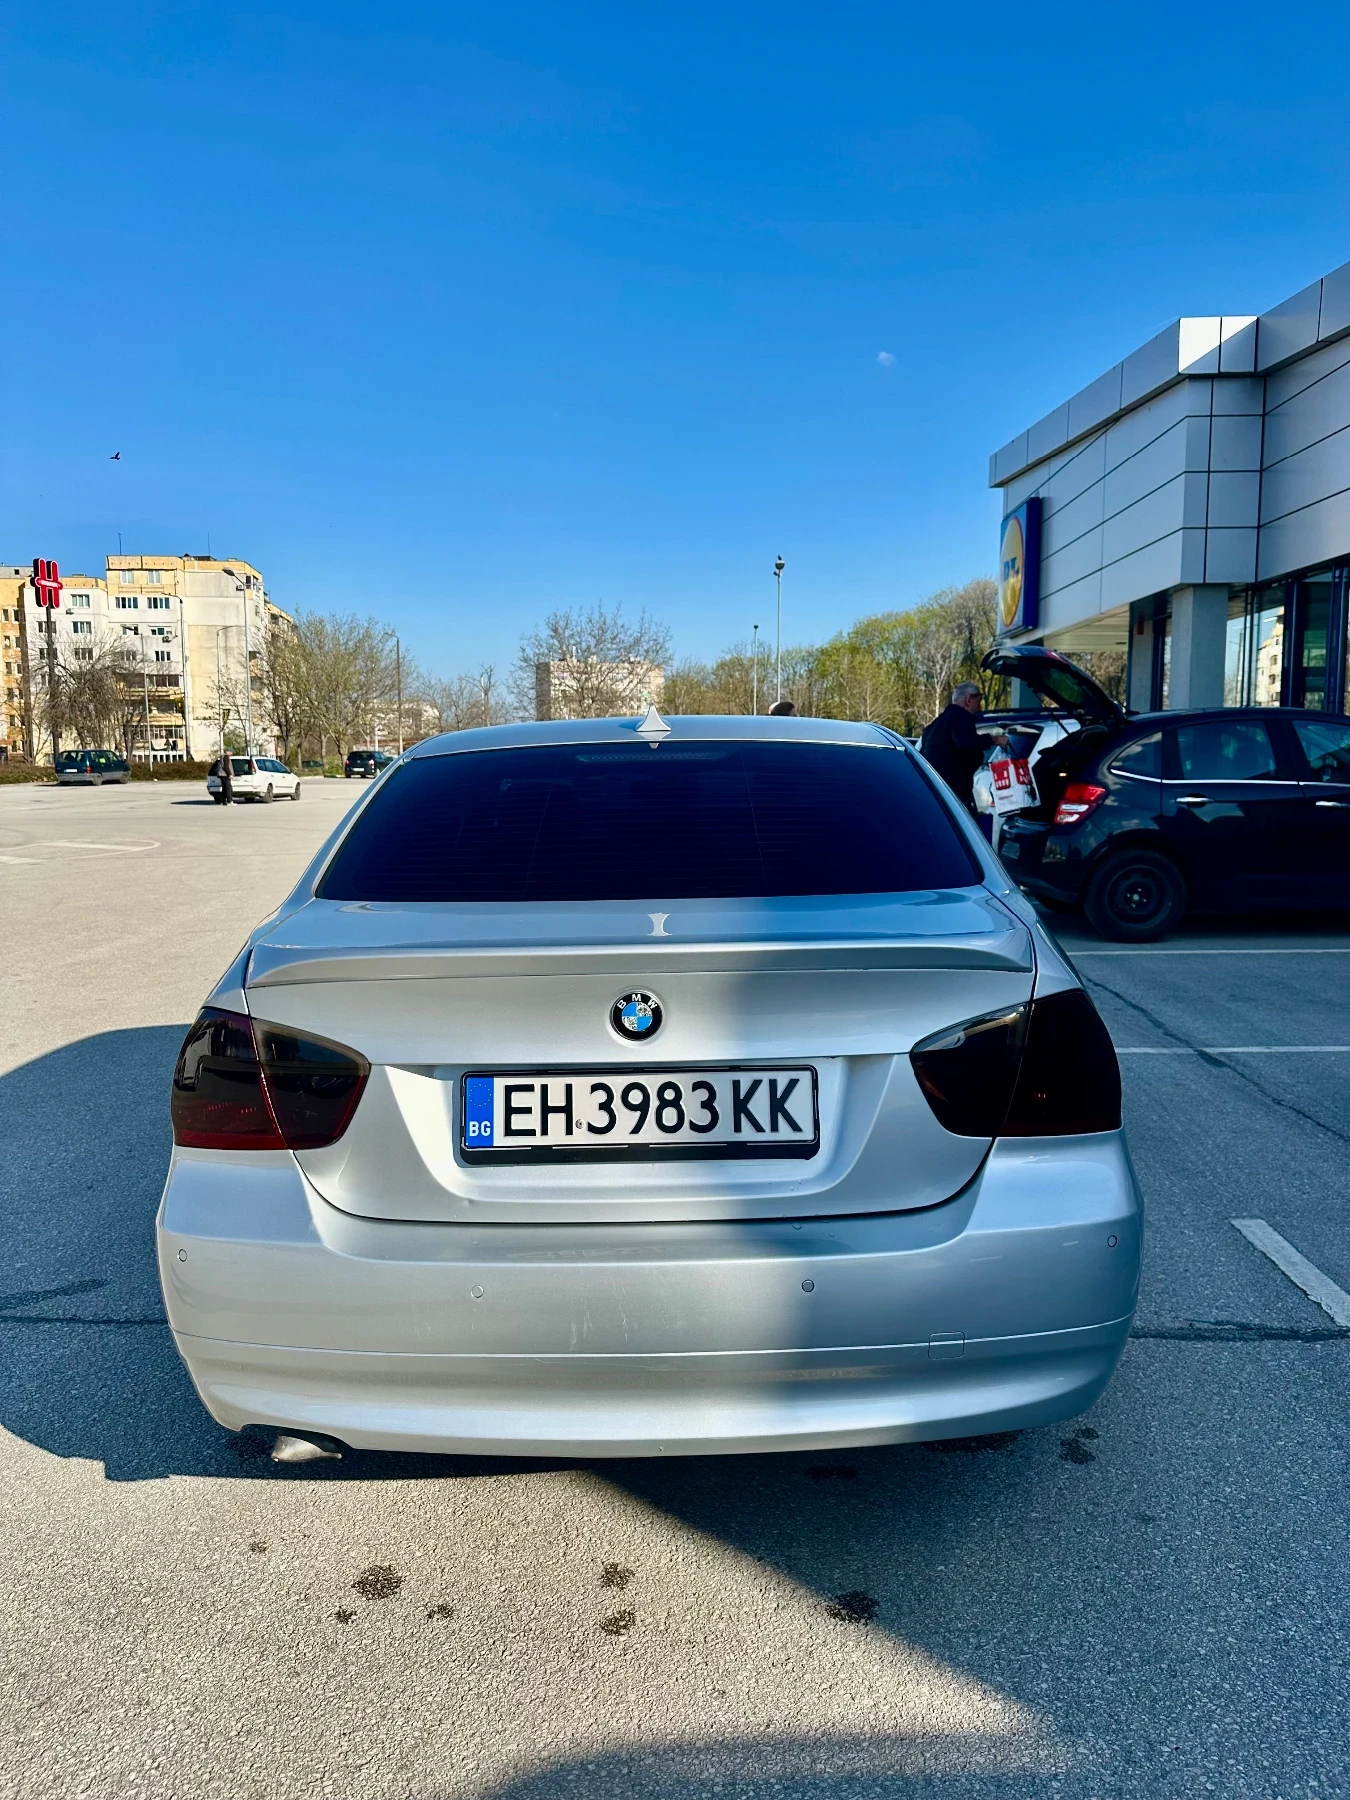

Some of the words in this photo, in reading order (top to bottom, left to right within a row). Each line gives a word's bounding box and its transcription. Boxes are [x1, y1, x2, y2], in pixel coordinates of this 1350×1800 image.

[617, 994, 658, 1009] BMW
[504, 1083, 574, 1137] EH
[587, 1081, 720, 1135] 3983
[732, 1078, 803, 1133] KK
[468, 1121, 491, 1137] BG
